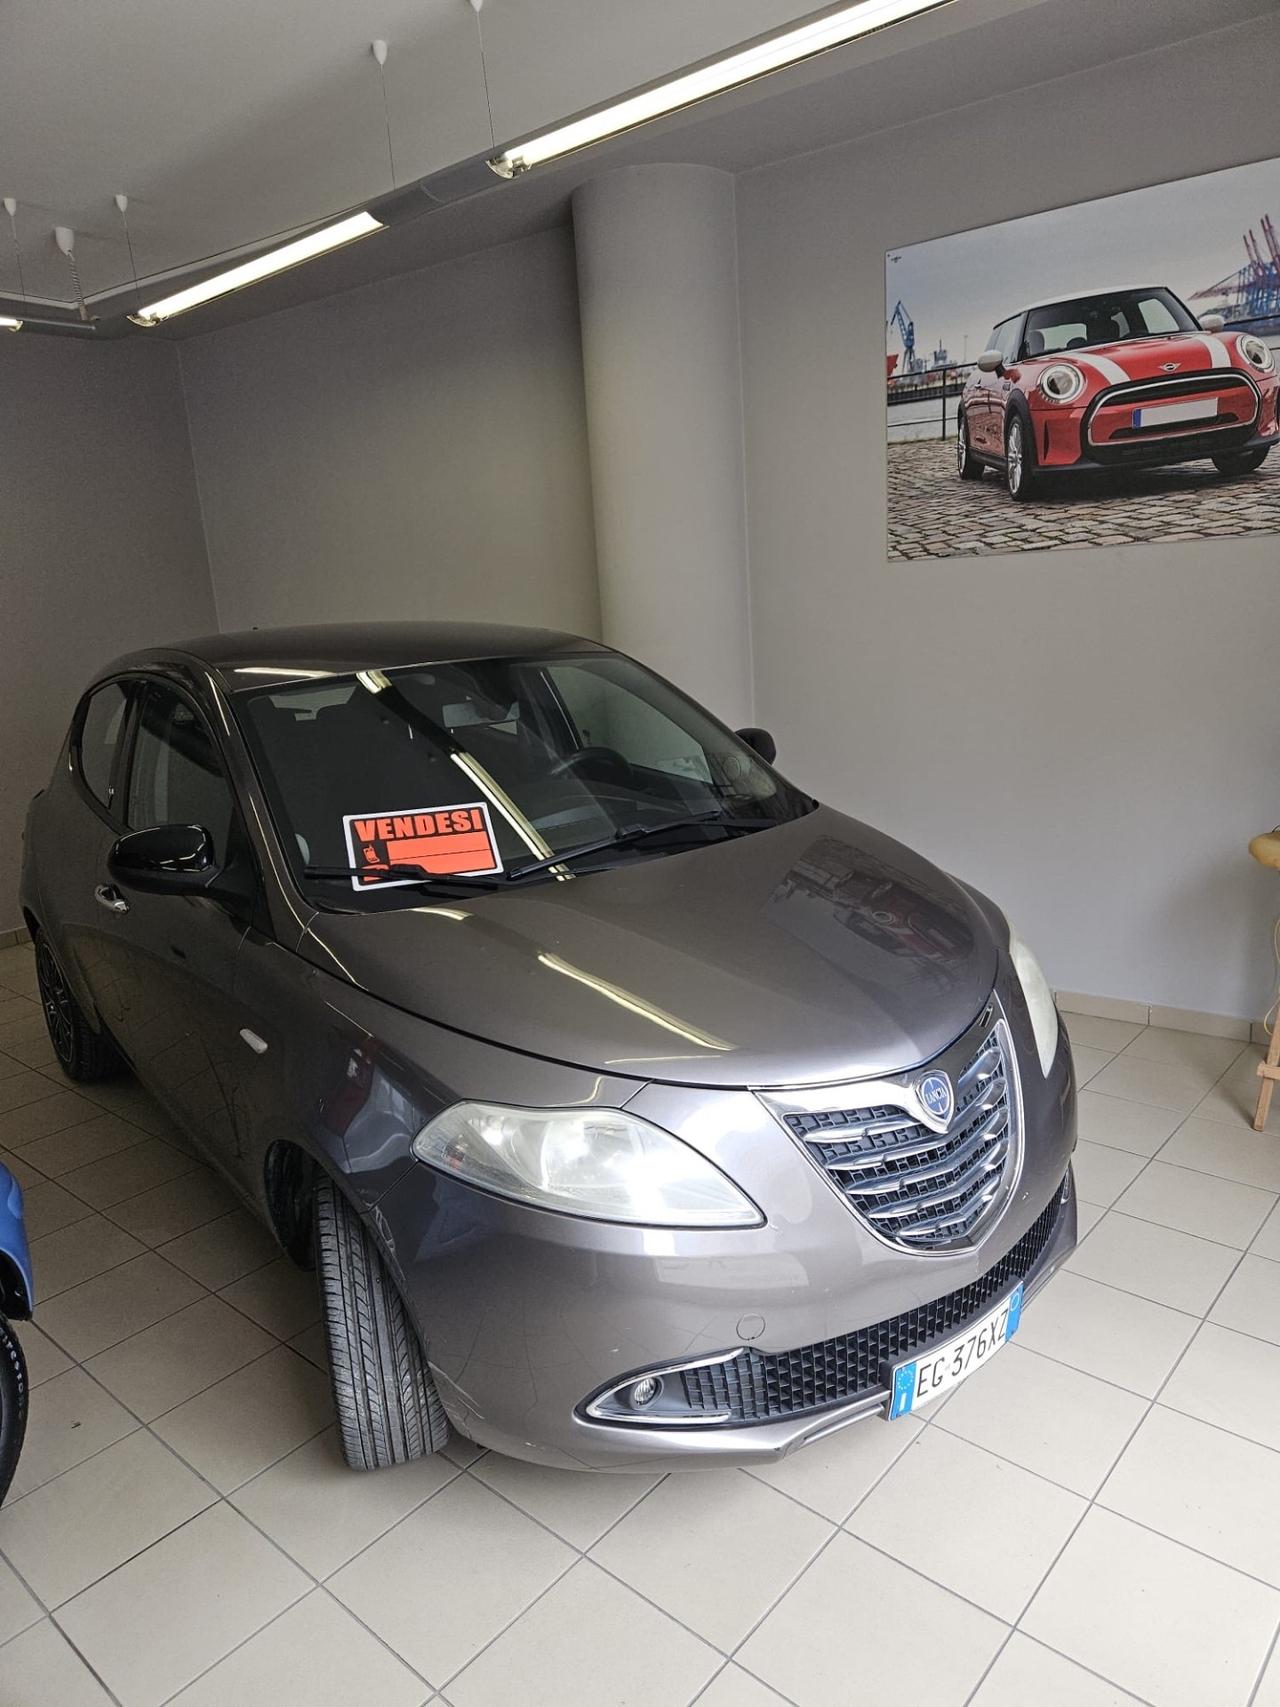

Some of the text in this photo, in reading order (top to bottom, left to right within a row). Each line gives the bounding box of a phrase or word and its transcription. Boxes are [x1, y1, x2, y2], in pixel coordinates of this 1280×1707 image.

[354, 809, 483, 842] VENDESI
[925, 1086, 947, 1104] LANCIA
[917, 1357, 945, 1398] EG
[951, 1308, 1009, 1377] 376XZ
